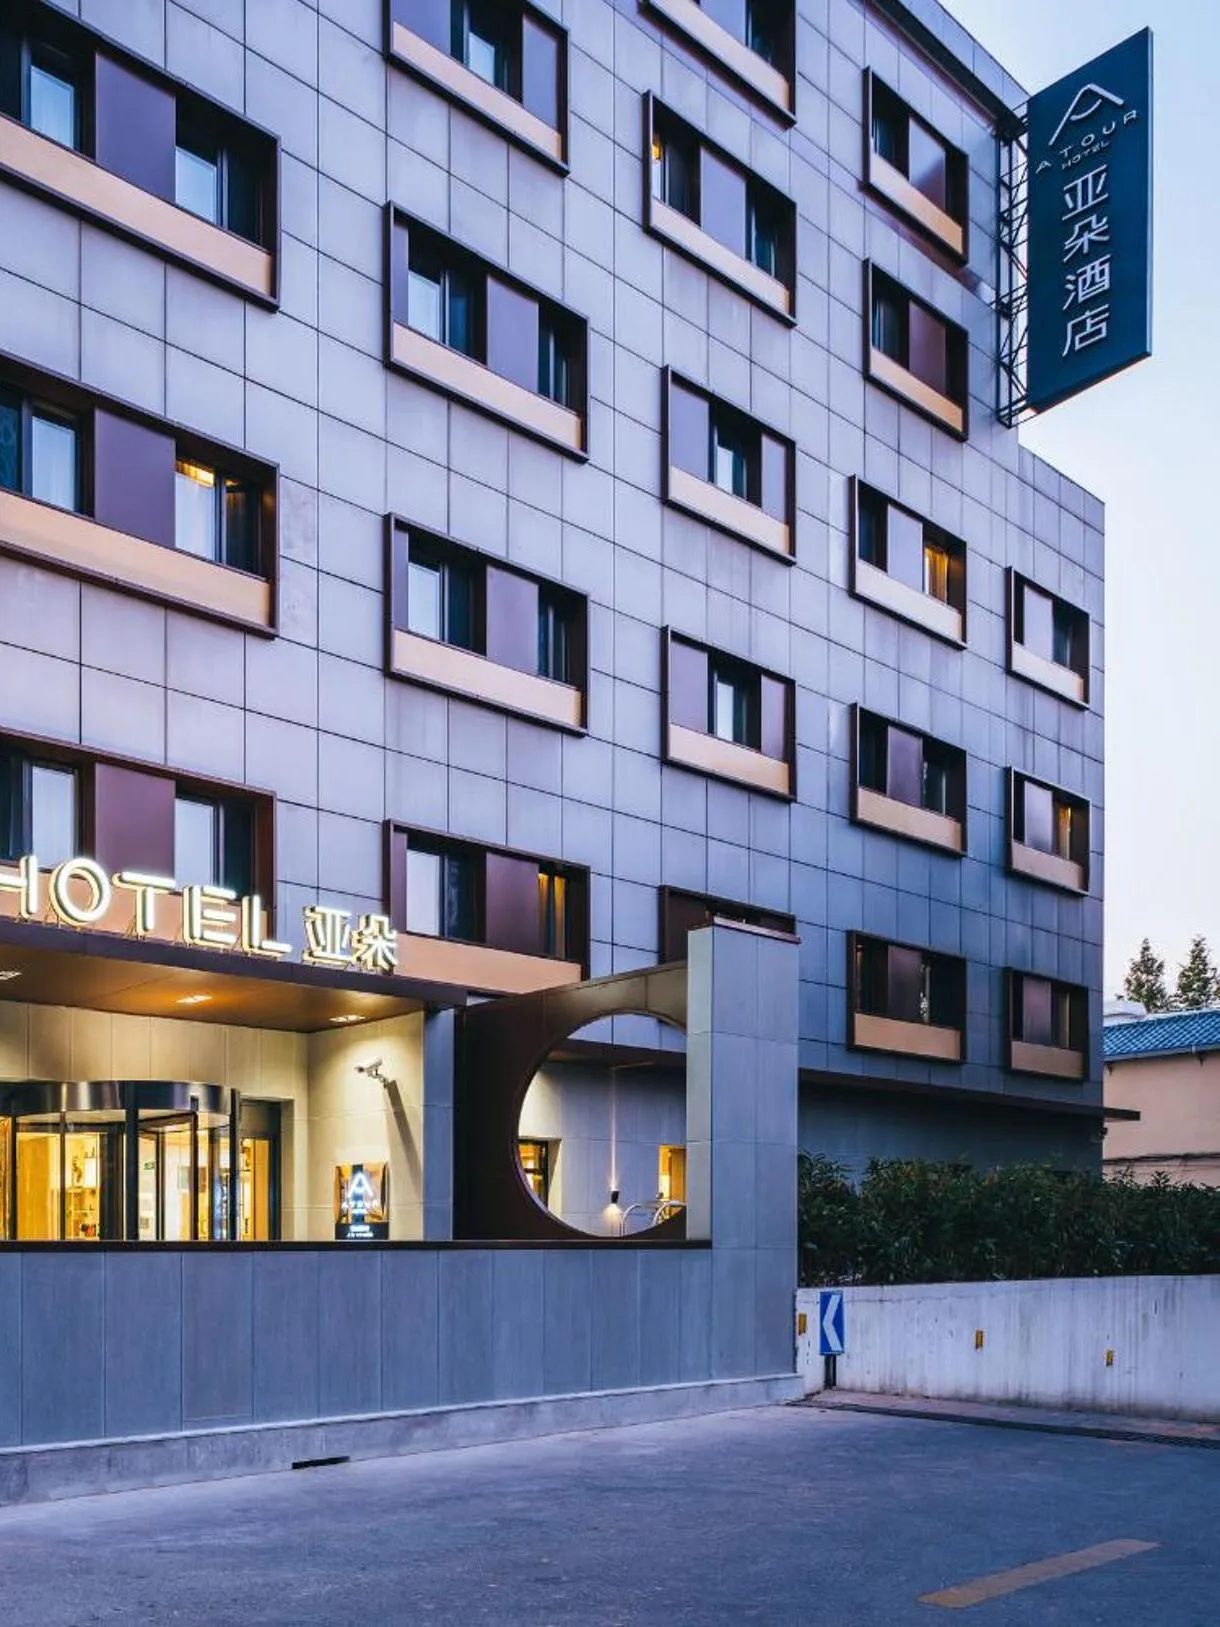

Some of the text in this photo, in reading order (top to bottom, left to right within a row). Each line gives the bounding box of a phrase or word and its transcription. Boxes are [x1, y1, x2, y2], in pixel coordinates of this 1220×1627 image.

[1035, 109, 1137, 174] ATOUR
[1061, 140, 1110, 170] HOTEL
[1061, 164, 1111, 357] 亚朵酒店
[302, 905, 398, 972] 亚朵
